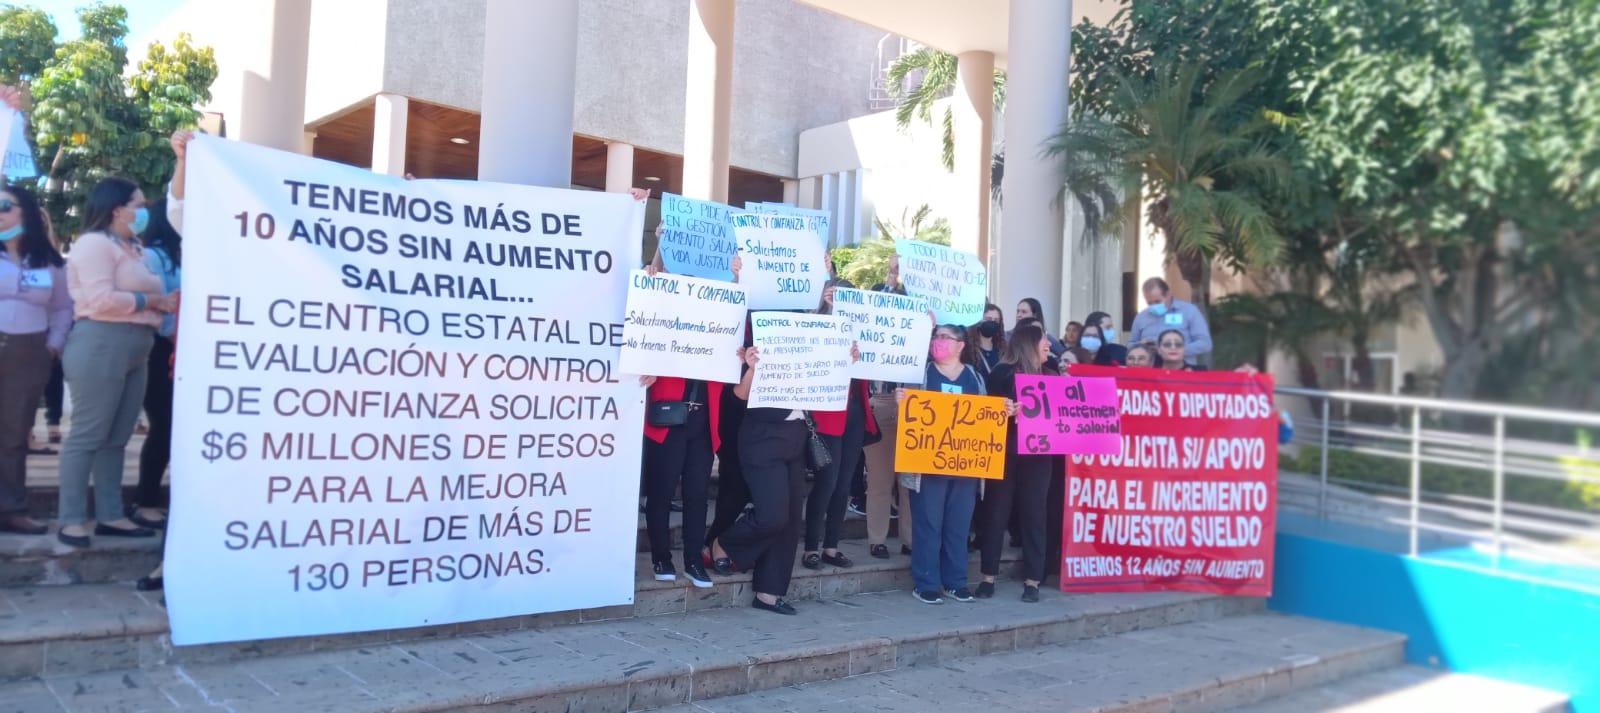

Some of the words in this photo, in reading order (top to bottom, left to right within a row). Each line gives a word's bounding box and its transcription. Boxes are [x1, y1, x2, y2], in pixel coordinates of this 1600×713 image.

[284, 180, 454, 225] TENEMOS
[463, 202, 532, 235] MÁS
[541, 212, 583, 237] DE
[666, 214, 681, 228] EN
[732, 214, 761, 228] CONTROL
[764, 217, 769, 229] Y
[234, 211, 276, 240] 10
[288, 218, 389, 256] AÑOS
[399, 233, 453, 261] SIN
[463, 240, 613, 274] AUMENTO
[909, 243, 937, 259] TODO
[662, 246, 669, 257] Y
[672, 248, 690, 265] VIDA
[758, 259, 796, 273] AUMENTO
[800, 263, 810, 273] DE
[341, 264, 535, 304] SALARIAL...
[634, 275, 680, 294] CONTROL
[688, 283, 695, 296] Y
[697, 285, 746, 306] CONFIANZA
[777, 277, 811, 294] SUELDO
[929, 279, 943, 294] SIN
[947, 284, 961, 297] UN
[834, 288, 865, 305] CONTROL
[868, 294, 874, 305] Y
[873, 294, 914, 311] CONFIANZA
[206, 295, 255, 326] EL
[268, 299, 430, 337] CENTRO
[442, 313, 581, 346] ESTATAL
[589, 322, 624, 347] DE
[757, 318, 791, 327] CONTROL
[795, 320, 800, 328] Y
[875, 315, 895, 328] MAS
[901, 318, 914, 330] DE
[860, 327, 885, 344] AÑOS
[891, 334, 906, 347] SIN
[214, 341, 447, 378] EVALUACIÓN
[457, 352, 478, 378] Y
[484, 353, 619, 383] CONTROL
[880, 354, 918, 367] SALARIAL
[760, 372, 792, 381] AUMENTO
[206, 386, 261, 416] DE
[273, 387, 481, 421] CONFIANZA
[489, 393, 619, 421] SOLICITA
[1064, 381, 1086, 402] al
[905, 394, 936, 426] C3
[951, 398, 976, 430] 12
[976, 406, 1007, 426] años
[1164, 391, 1175, 417] Y
[1179, 391, 1271, 420] DIPUTADOS
[1055, 422, 1071, 434] to
[1076, 419, 1120, 435] salarial
[201, 430, 247, 463] $6
[261, 432, 452, 461] MILLONES
[463, 434, 507, 460] DE
[518, 433, 615, 459] PESOS
[905, 428, 935, 451] Sin
[939, 427, 1003, 453] Aumento
[1025, 434, 1050, 453] C3
[932, 451, 991, 472] Salarial
[1182, 438, 1203, 469] SU
[1205, 437, 1265, 470] APOYO
[266, 475, 373, 504] PARA
[386, 475, 429, 502] LA
[440, 472, 567, 501] MEJORA
[1068, 477, 1119, 510] PARA
[1124, 480, 1146, 510] EL
[1151, 480, 1267, 512] INCREMENTO
[224, 517, 411, 550] SALARIAL
[422, 513, 468, 543] DE
[478, 507, 543, 539] MÁS
[553, 508, 592, 534] DE
[1072, 511, 1097, 544] DE
[1101, 514, 1187, 548] NUESTRO
[1191, 515, 1263, 548] SUELDO
[289, 562, 349, 592] 130
[361, 549, 551, 588] PERSONAS.
[1066, 555, 1123, 578] TENEMOS
[1126, 557, 1140, 576] 12
[1142, 555, 1181, 577] AÑOS
[1181, 558, 1205, 576] SIN
[1205, 558, 1264, 579] AUMENTO
